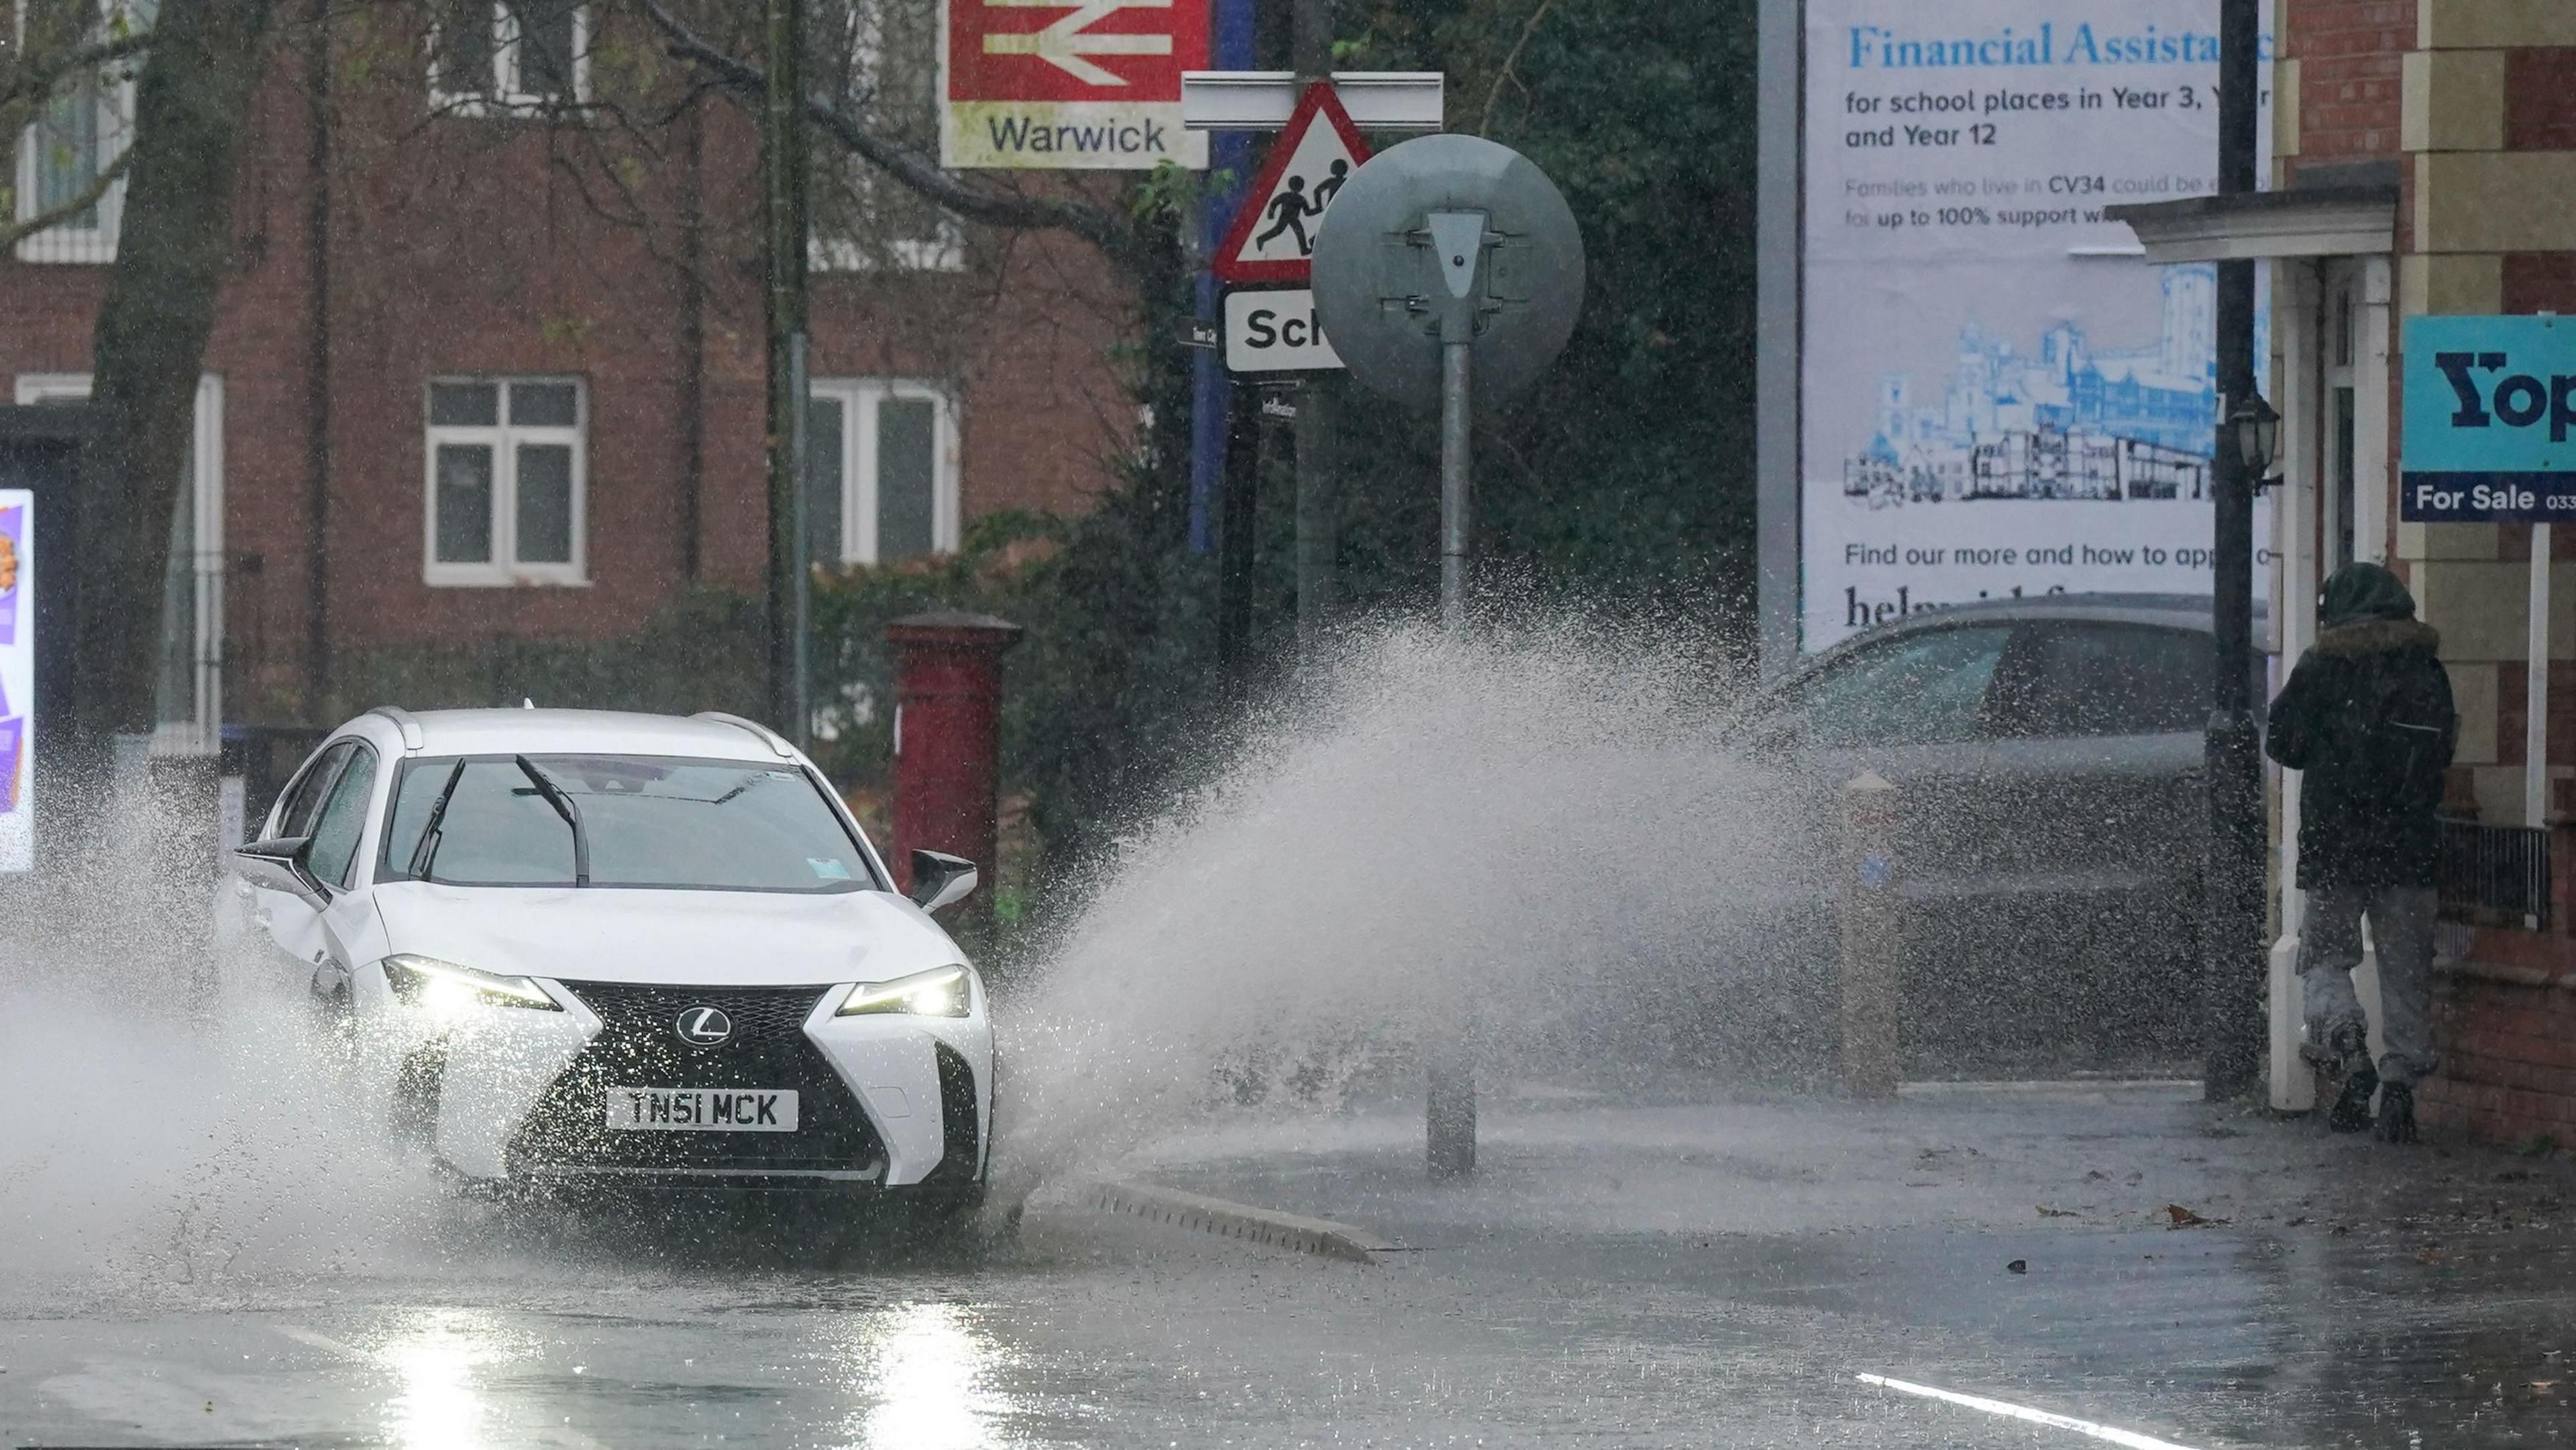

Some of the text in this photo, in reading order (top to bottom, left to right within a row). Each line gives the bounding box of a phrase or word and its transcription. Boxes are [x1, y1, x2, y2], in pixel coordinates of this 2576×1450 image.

[1849, 22, 2052, 67] Financial
[1845, 91, 1881, 113] for
[1890, 89, 1976, 113] school
[1984, 88, 2070, 117] places
[2080, 87, 2102, 110] in
[2112, 86, 2170, 109] Year
[2180, 85, 2202, 110] 3,
[989, 116, 1166, 153] Warwick
[1845, 123, 1997, 148] and Year 12
[1934, 177, 1976, 196] who
[2048, 175, 2105, 195] CV34
[2112, 174, 2170, 195] could
[2176, 174, 2202, 193] be
[1877, 211, 1904, 230] up
[1910, 209, 1931, 226] to
[1937, 207, 1991, 226] 100%
[1996, 207, 2077, 228] support
[2416, 485, 2465, 510] For
[2471, 484, 2536, 510] Sale
[1845, 542, 1898, 565] Find
[1906, 547, 1945, 565] our
[1954, 547, 2017, 565] more
[2026, 543, 2073, 565] and
[2082, 543, 2135, 565] how
[2143, 544, 2167, 565] to
[628, 1092, 777, 1125] TN51 MCK
